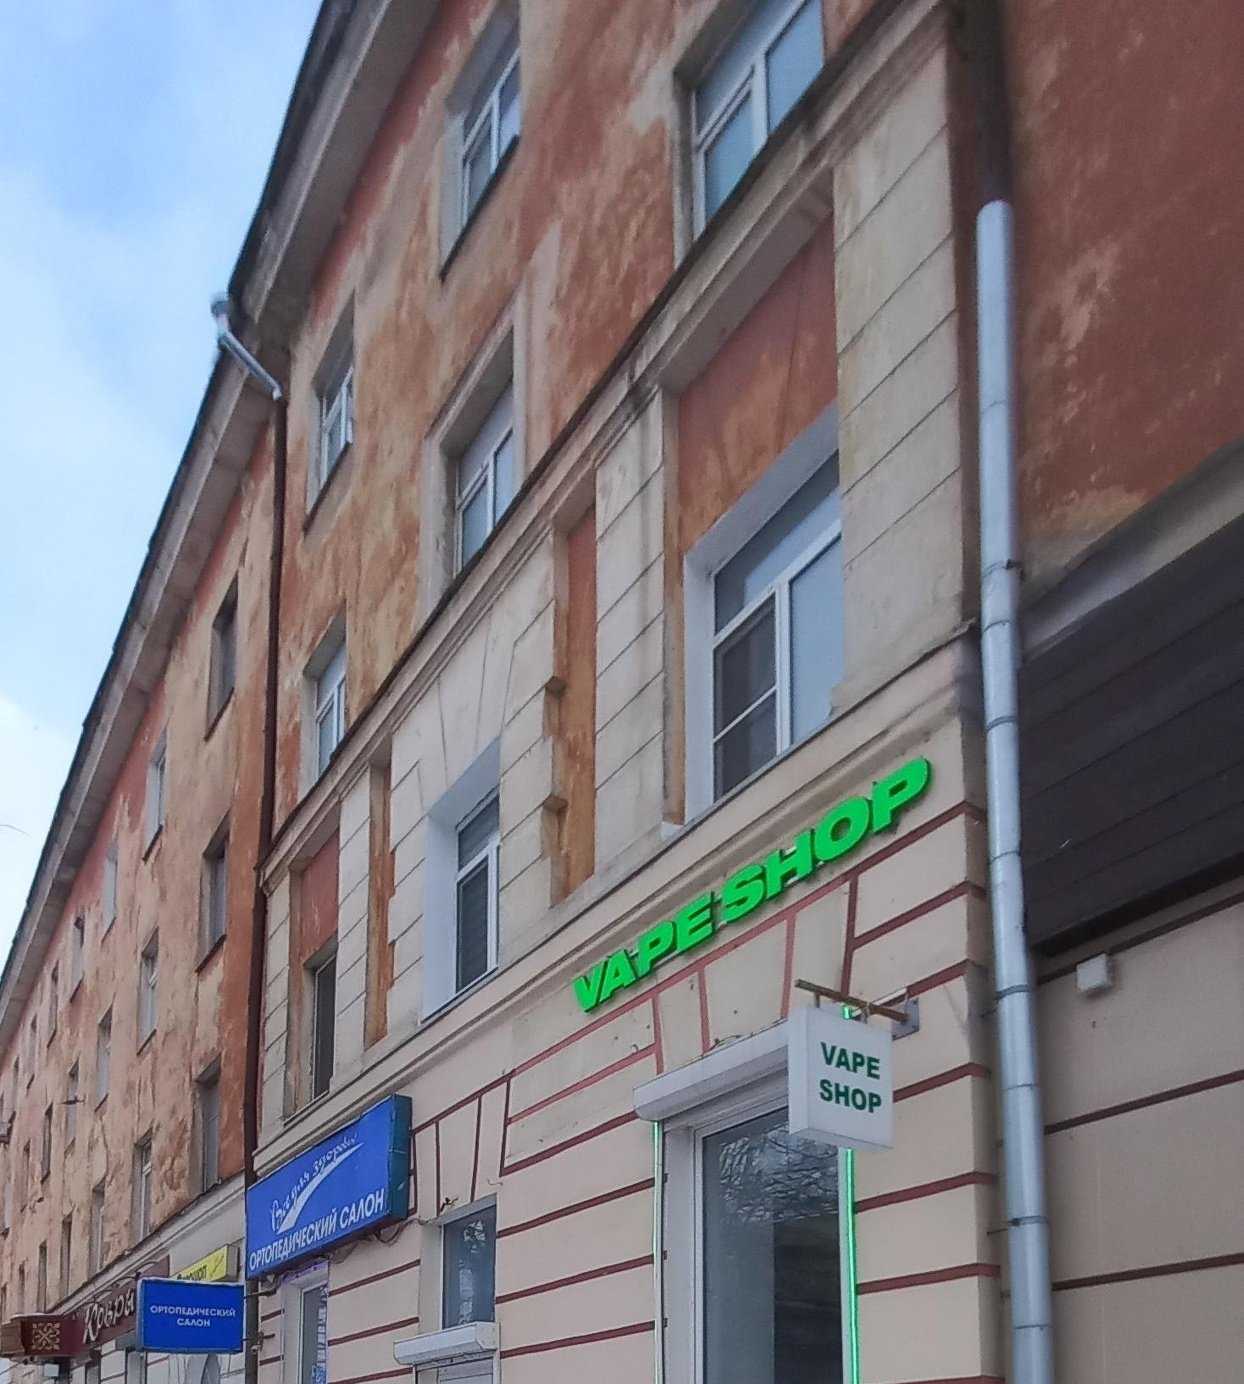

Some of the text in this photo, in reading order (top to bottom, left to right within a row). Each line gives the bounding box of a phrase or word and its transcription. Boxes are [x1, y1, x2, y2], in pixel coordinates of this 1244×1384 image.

[572, 756, 932, 1013] VAPE SHOP
[820, 1042, 881, 1080] VAPE
[819, 1079, 883, 1113] SHOP
[249, 1188, 385, 1271] ОРТОПЕДИЧЕСКИЙ САЛОН
[150, 1304, 236, 1317] ОРТОПЕДИЧЕСКИЙ
[176, 1318, 211, 1328] САЛОН
